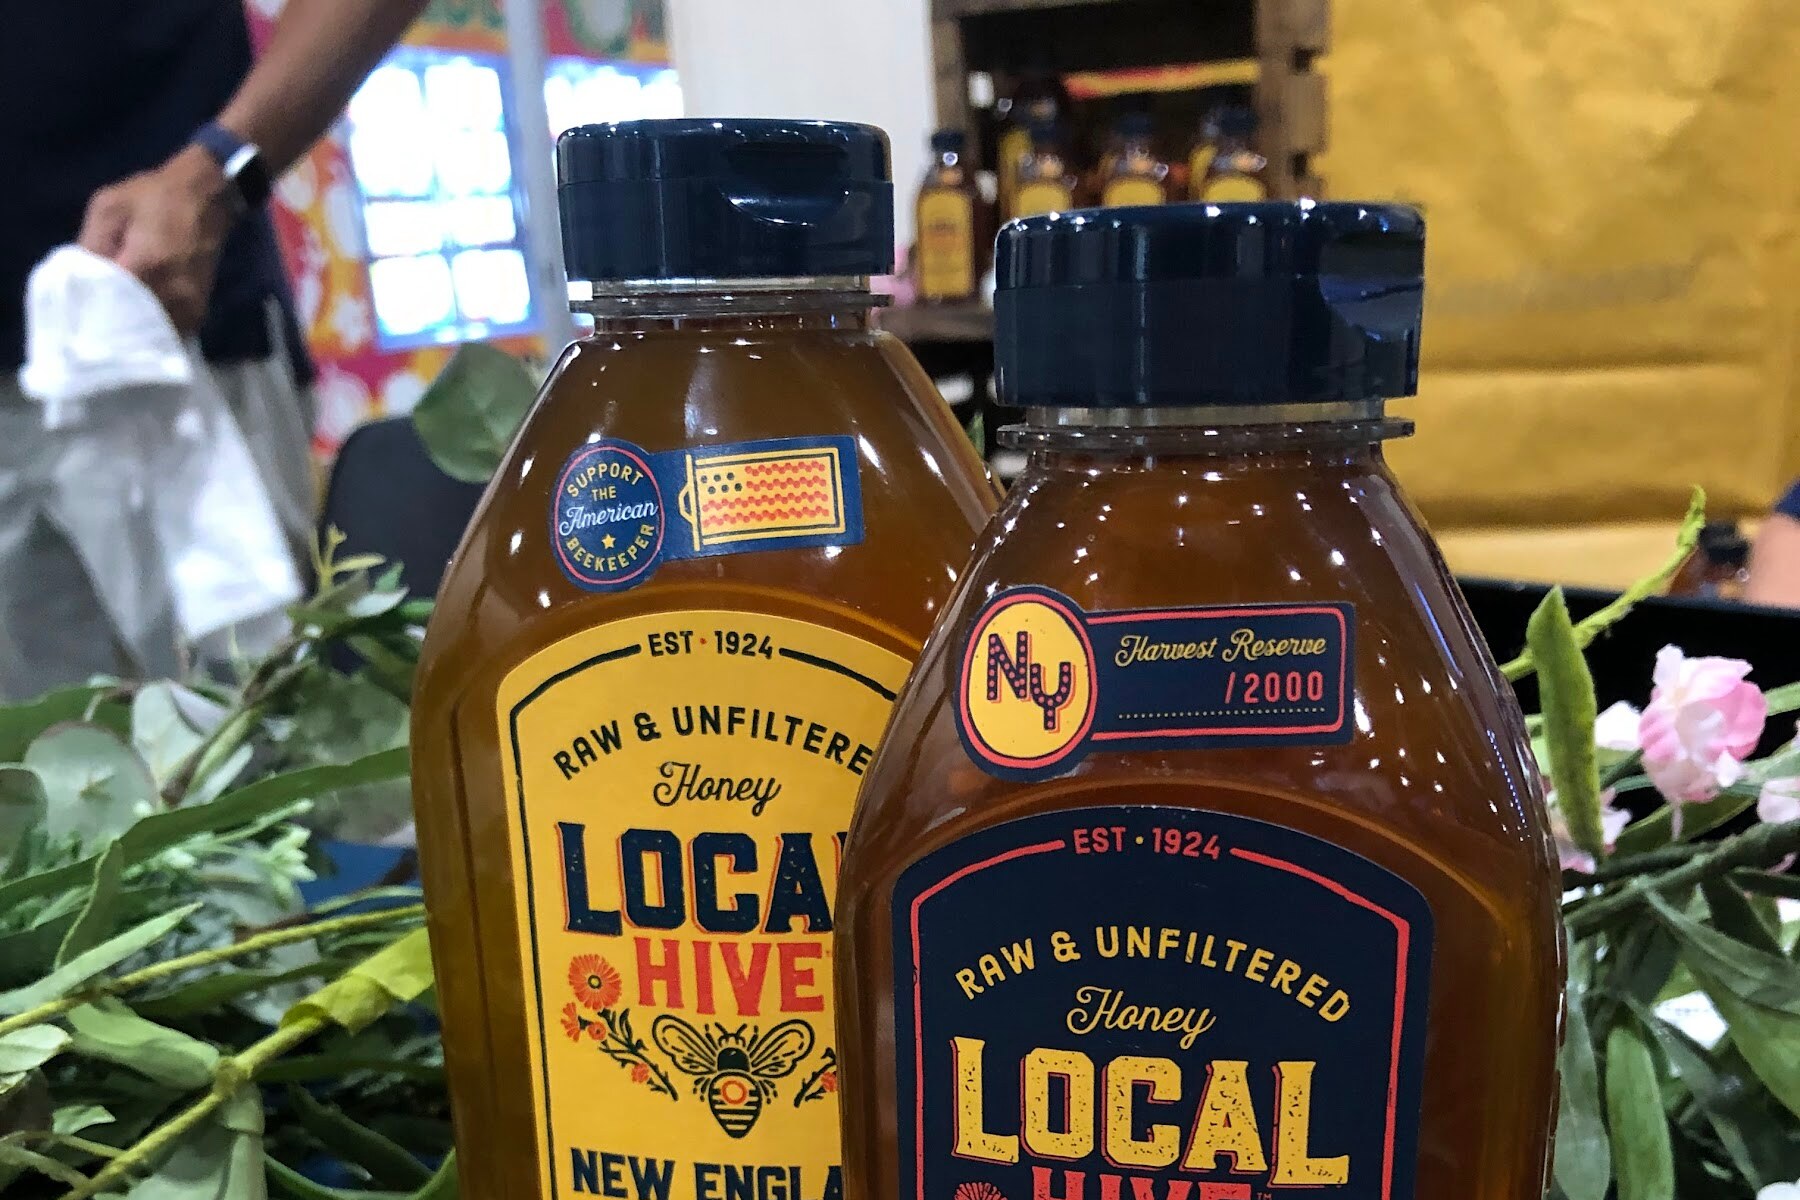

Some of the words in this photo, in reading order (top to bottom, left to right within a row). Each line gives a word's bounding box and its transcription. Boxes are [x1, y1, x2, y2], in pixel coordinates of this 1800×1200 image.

[567, 462, 644, 497] SUPPORT
[591, 486, 616, 501] THE
[559, 502, 659, 535] American
[566, 524, 655, 572] BEEKEEPER
[648, 630, 694, 657] EST
[714, 630, 774, 660] 1924
[1114, 633, 1218, 668] Harvest
[1221, 628, 1327, 663] Reserve
[1224, 671, 1324, 705] /2000
[553, 719, 623, 781] RAW
[636, 712, 662, 742] &
[653, 761, 782, 817] Honey
[1073, 826, 1126, 855] EST
[1151, 827, 1221, 860] 1924
[633, 937, 825, 1017] HIVE
[955, 938, 1035, 1000] RAW
[1050, 930, 1081, 962] &
[1095, 925, 1351, 1023] UNFILTERED
[1066, 985, 1217, 1050] Honey
[948, 1036, 1351, 1188] LOCAL
